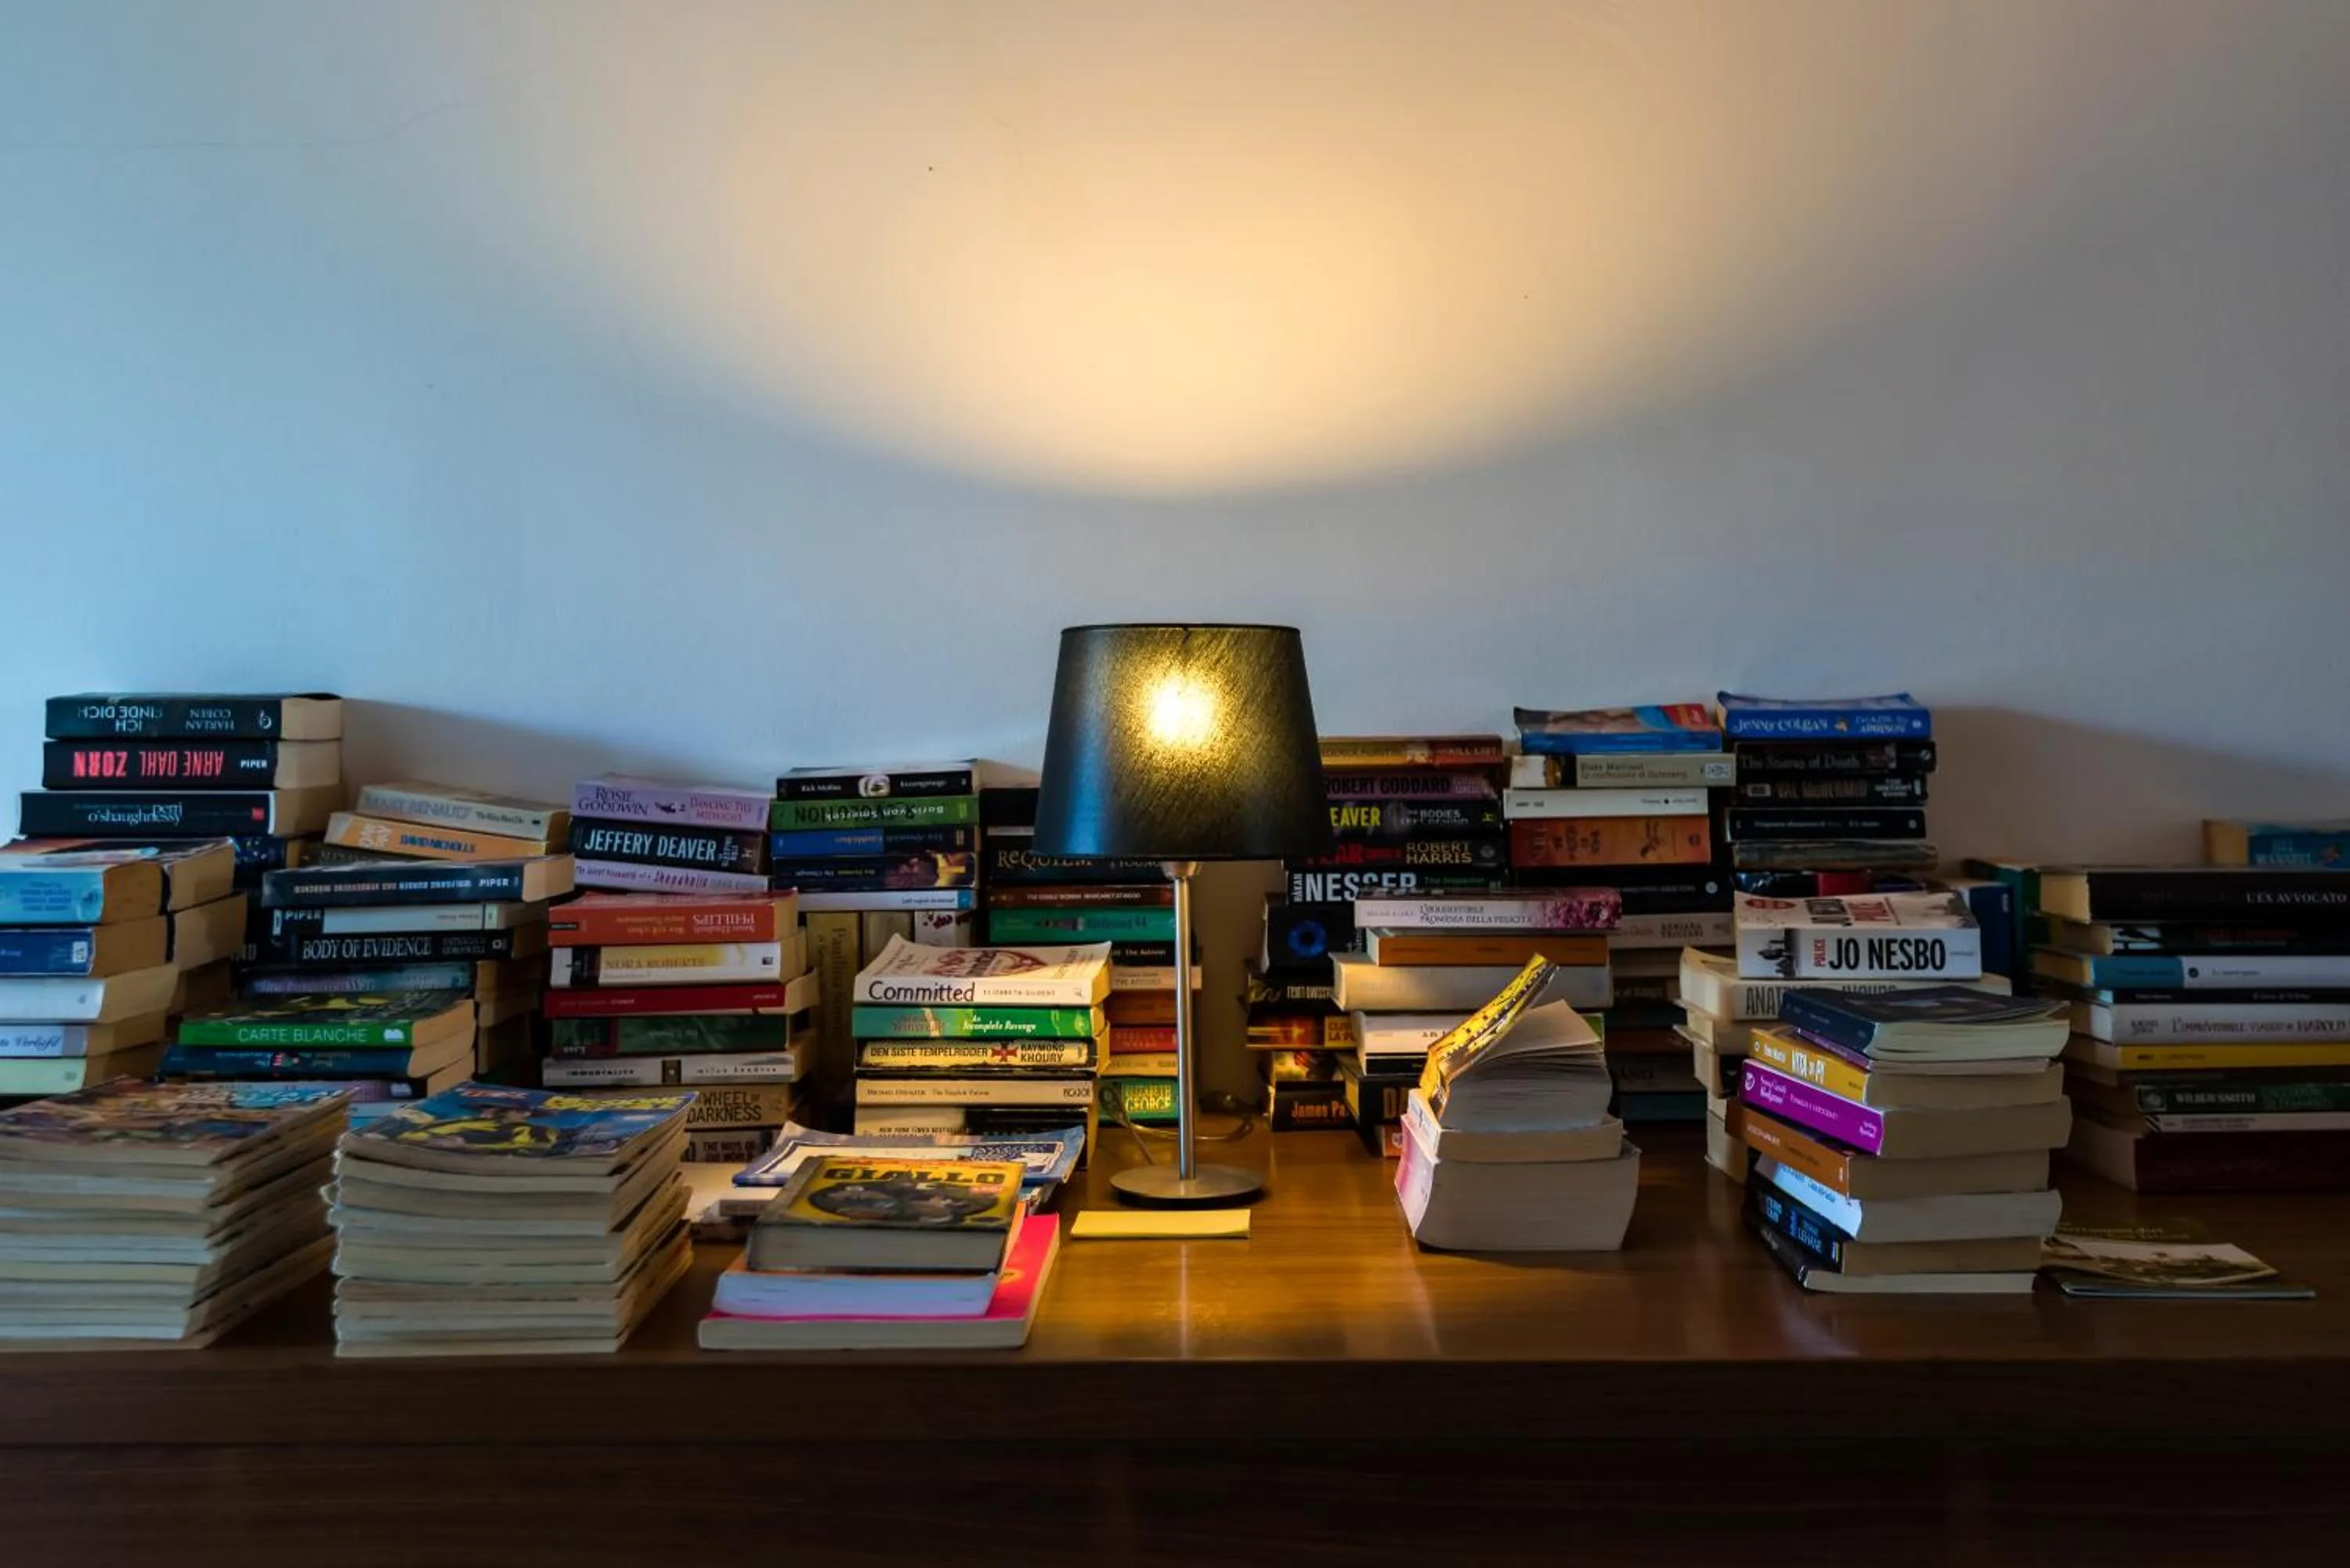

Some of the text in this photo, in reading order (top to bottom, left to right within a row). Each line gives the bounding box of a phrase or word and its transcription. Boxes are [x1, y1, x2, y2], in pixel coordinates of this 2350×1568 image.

[189, 709, 232, 719] COBEN
[115, 720, 143, 733] ICH
[185, 720, 235, 732] HARLAN
[73, 750, 225, 778] ARNE DAHL ZORN
[240, 758, 268, 769] PIPER
[578, 797, 649, 817] GOODWIN
[1329, 805, 1382, 828] EAVER
[584, 829, 654, 855] JEFFERY
[656, 835, 718, 862] DEAVER
[1406, 841, 1470, 854] ROBERT
[1406, 852, 1473, 865] HARRIS
[692, 913, 755, 925] PHILLIPS
[302, 936, 432, 960] BODY OF EVIDENCE
[1828, 938, 1860, 970] JO
[869, 980, 975, 1003] Committed
[237, 1028, 369, 1043] CARTE BLANCHE
[870, 1046, 890, 1057] DEN
[1020, 1043, 1065, 1053] RAYMOND
[1020, 1053, 1064, 1064] KHOURY
[701, 1090, 753, 1107] WHEEL
[685, 1104, 763, 1124] DARKNESS
[824, 1167, 1006, 1184] GIALLO
